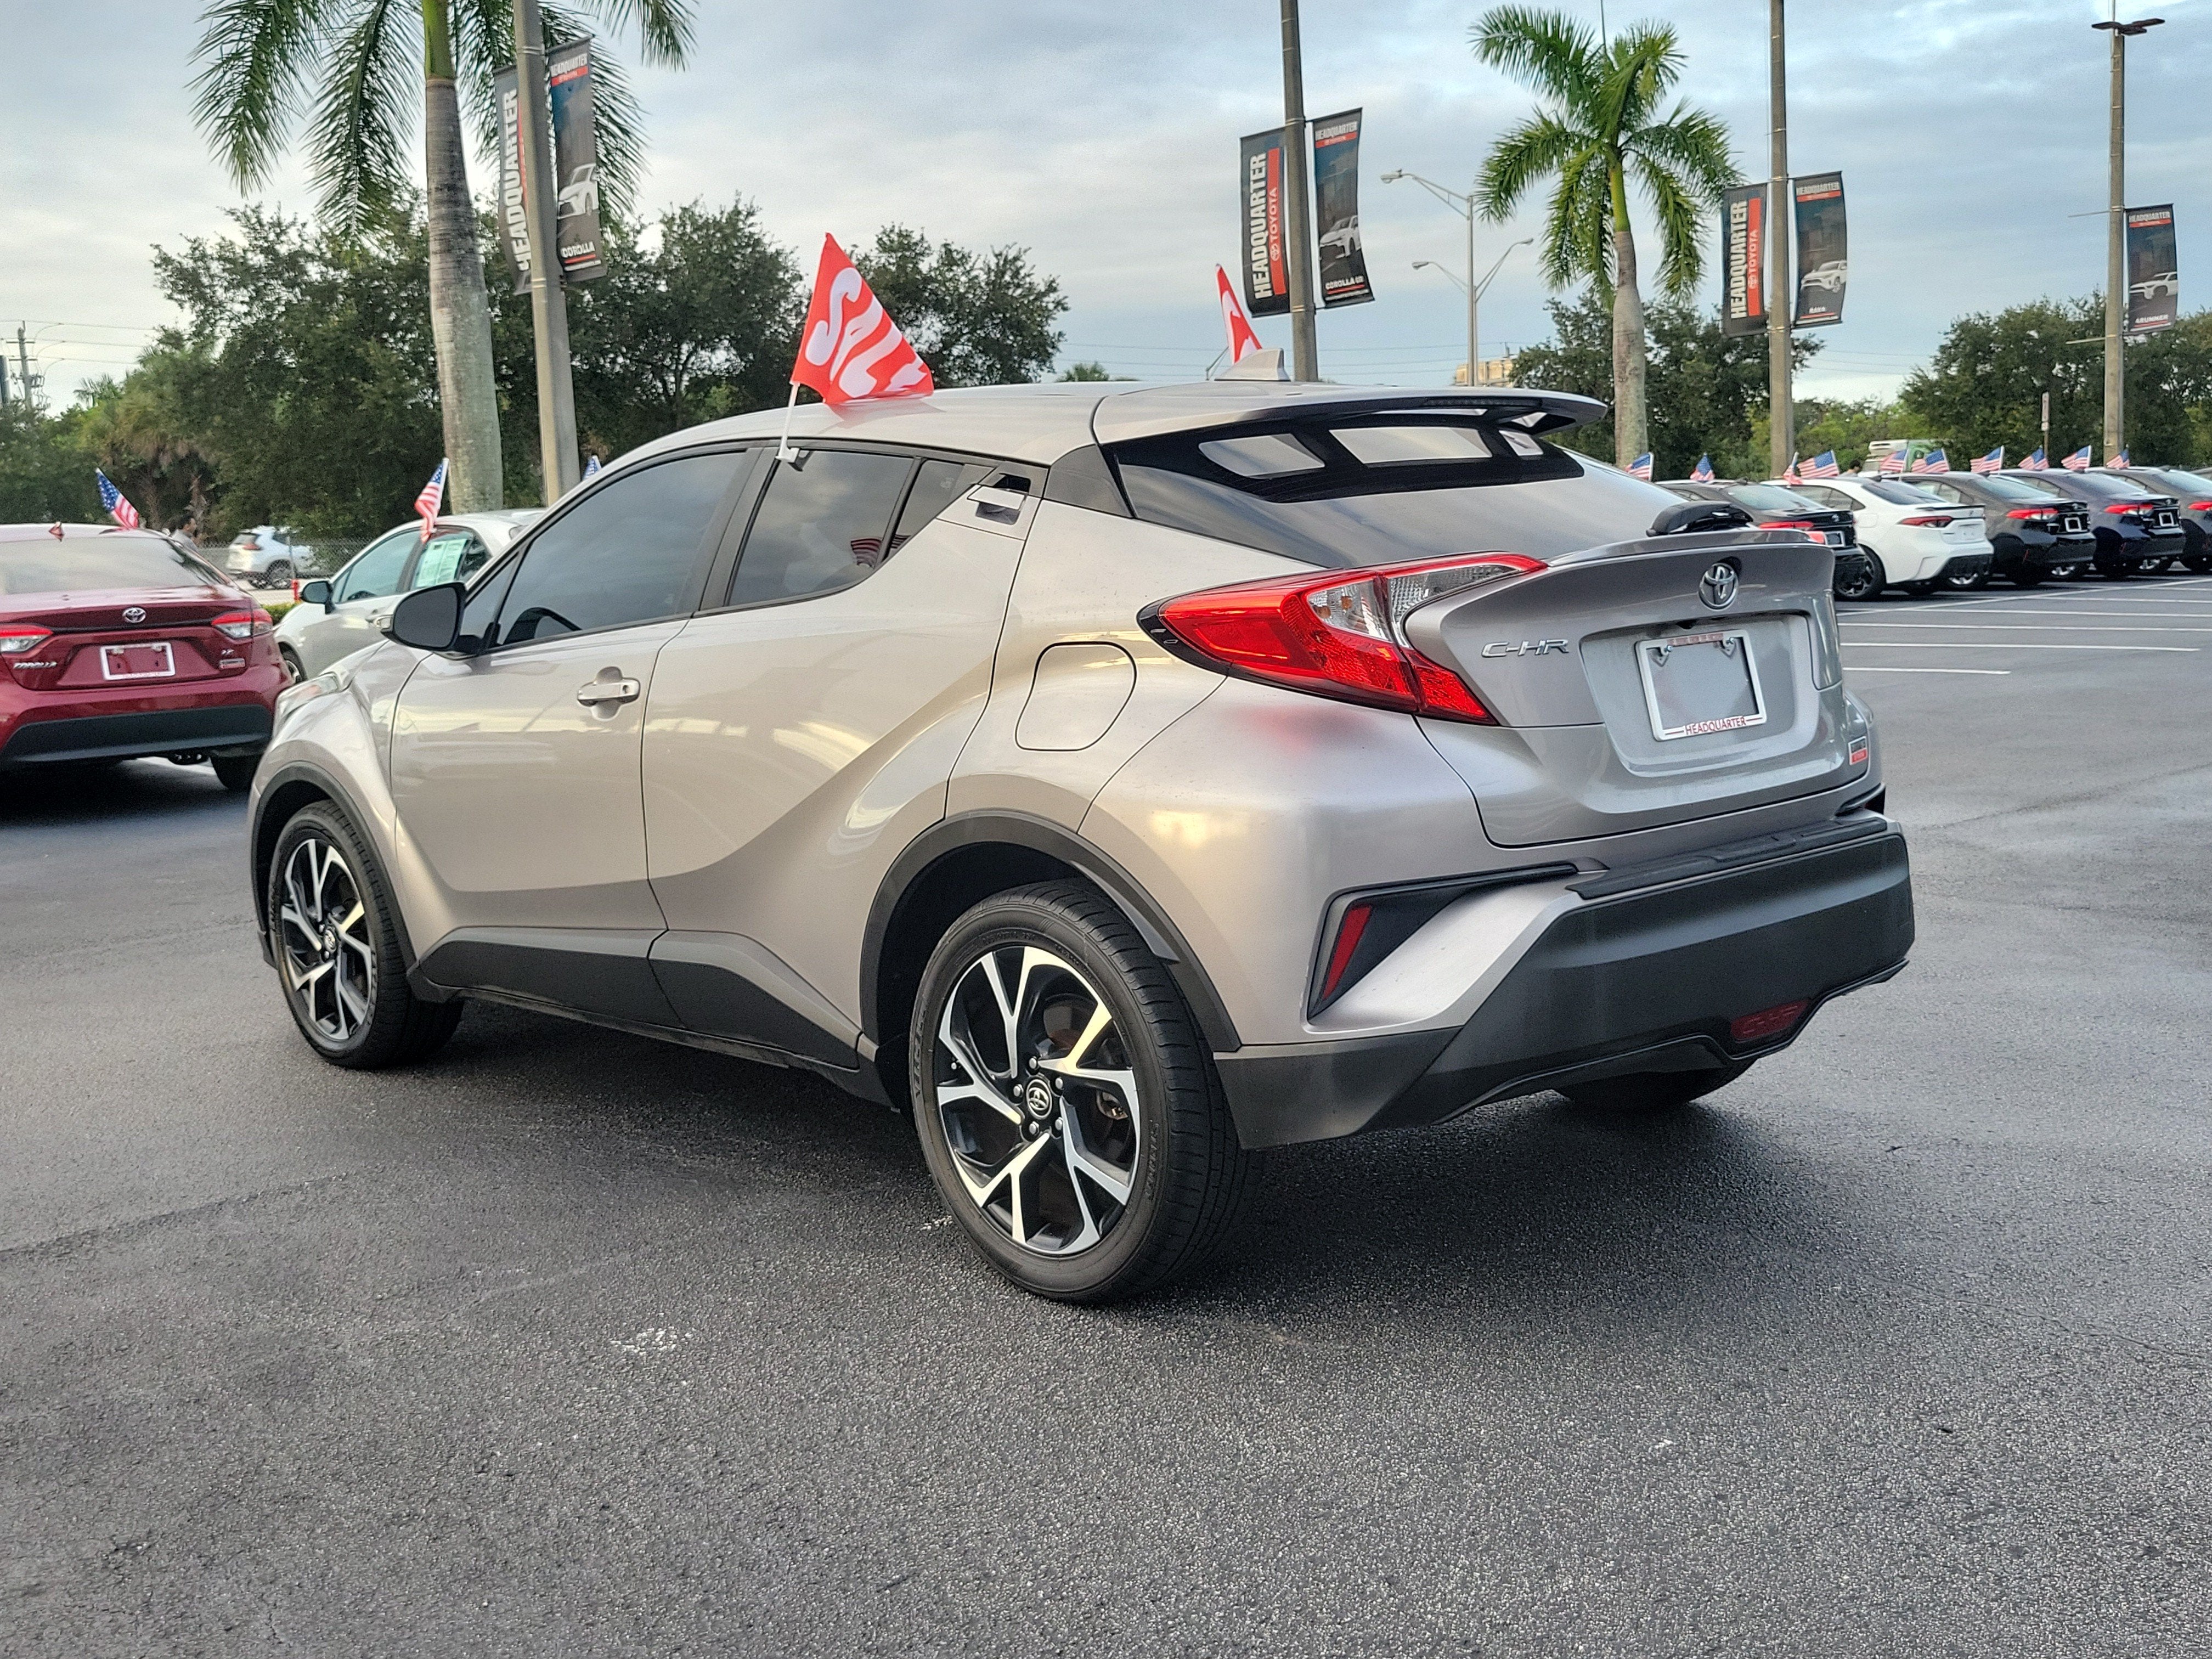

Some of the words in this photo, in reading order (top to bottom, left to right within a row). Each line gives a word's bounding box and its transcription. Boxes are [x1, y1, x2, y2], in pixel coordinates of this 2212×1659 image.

[1316, 121, 1357, 140] HEADQUARTER
[503, 89, 531, 272] HEADQUARTER
[1250, 152, 1272, 299] HEADQUARTER
[1268, 187, 1280, 244] TOYOTA
[561, 241, 595, 258] COROLLA
[1730, 200, 1747, 319] HEADQUARTER
[1748, 229, 1759, 276] TOYOTA
[1325, 277, 1355, 290] COROLLA
[1481, 639, 1570, 658] C-HR
[1685, 716, 1746, 735] HEADQUARTER
